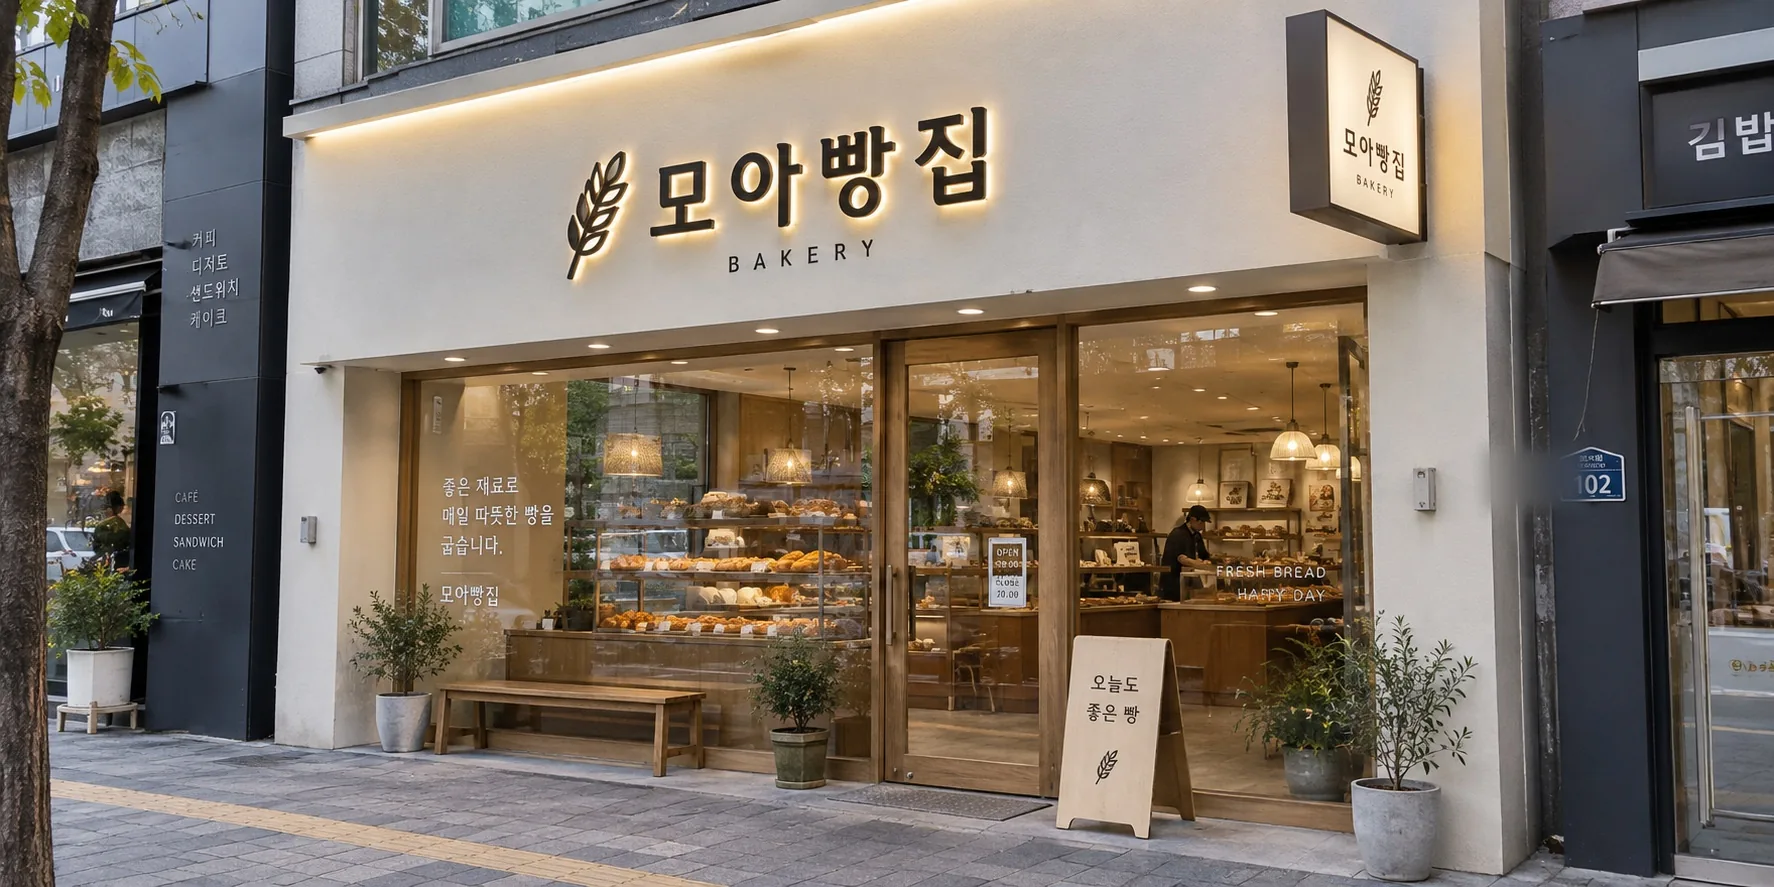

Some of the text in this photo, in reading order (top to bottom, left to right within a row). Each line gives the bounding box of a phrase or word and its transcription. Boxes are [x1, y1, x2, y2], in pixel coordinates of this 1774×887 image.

[1688, 111, 1774, 162] 김밥
[1343, 128, 1404, 181] 모아빵집
[650, 106, 988, 237] 모아빵집
[1356, 174, 1394, 198] BAKERY
[192, 228, 216, 248] 커피
[192, 253, 228, 275] 디저토
[728, 239, 874, 273] BAKERY
[442, 476, 519, 497] 좋은 재료로
[1574, 474, 1611, 494] 102
[174, 513, 216, 525] DESSERT
[442, 504, 554, 526] 매일 따뜻한 빵을
[173, 536, 224, 548] SANDWICH
[440, 535, 503, 556] 굽습니다.
[996, 548, 1019, 557] OPEN
[172, 558, 197, 571] CAKE
[1216, 565, 1326, 579] FRESH BREAD
[440, 584, 499, 607] 모아빵집
[1293, 589, 1326, 602] DAY
[1090, 675, 1139, 693] 오늘도
[1087, 703, 1140, 725] 좋은 빵
